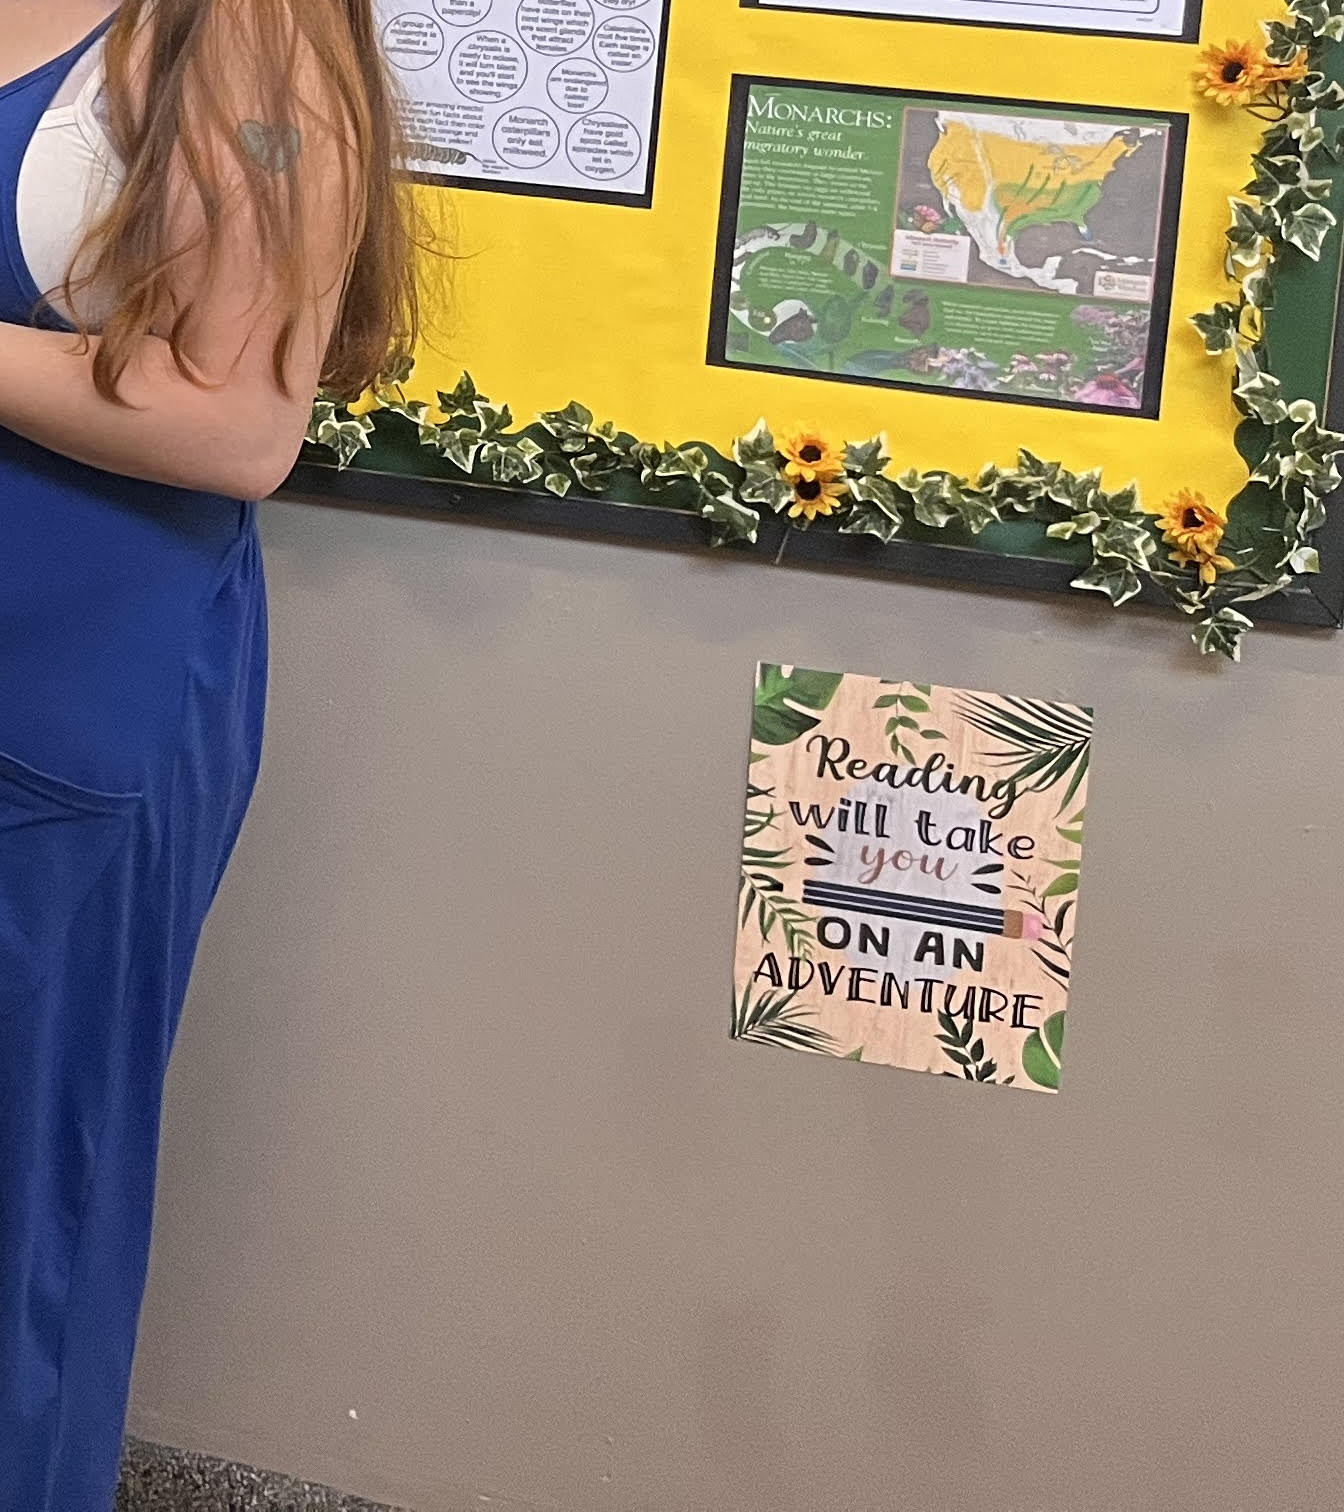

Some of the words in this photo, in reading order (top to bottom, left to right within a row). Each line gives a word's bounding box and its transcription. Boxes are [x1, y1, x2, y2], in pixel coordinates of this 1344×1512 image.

[745, 119, 804, 138] Nature's
[806, 128, 843, 142] great
[747, 95, 892, 129] MONARCHS:
[743, 140, 810, 159] migratory
[813, 145, 866, 161] wonder
[806, 734, 1027, 818] Reading
[789, 797, 891, 840] will
[914, 809, 1036, 861] take
[857, 844, 963, 884] you
[815, 915, 890, 958] ON
[914, 930, 985, 973] AN
[753, 952, 1044, 1030] ADVENTURE
